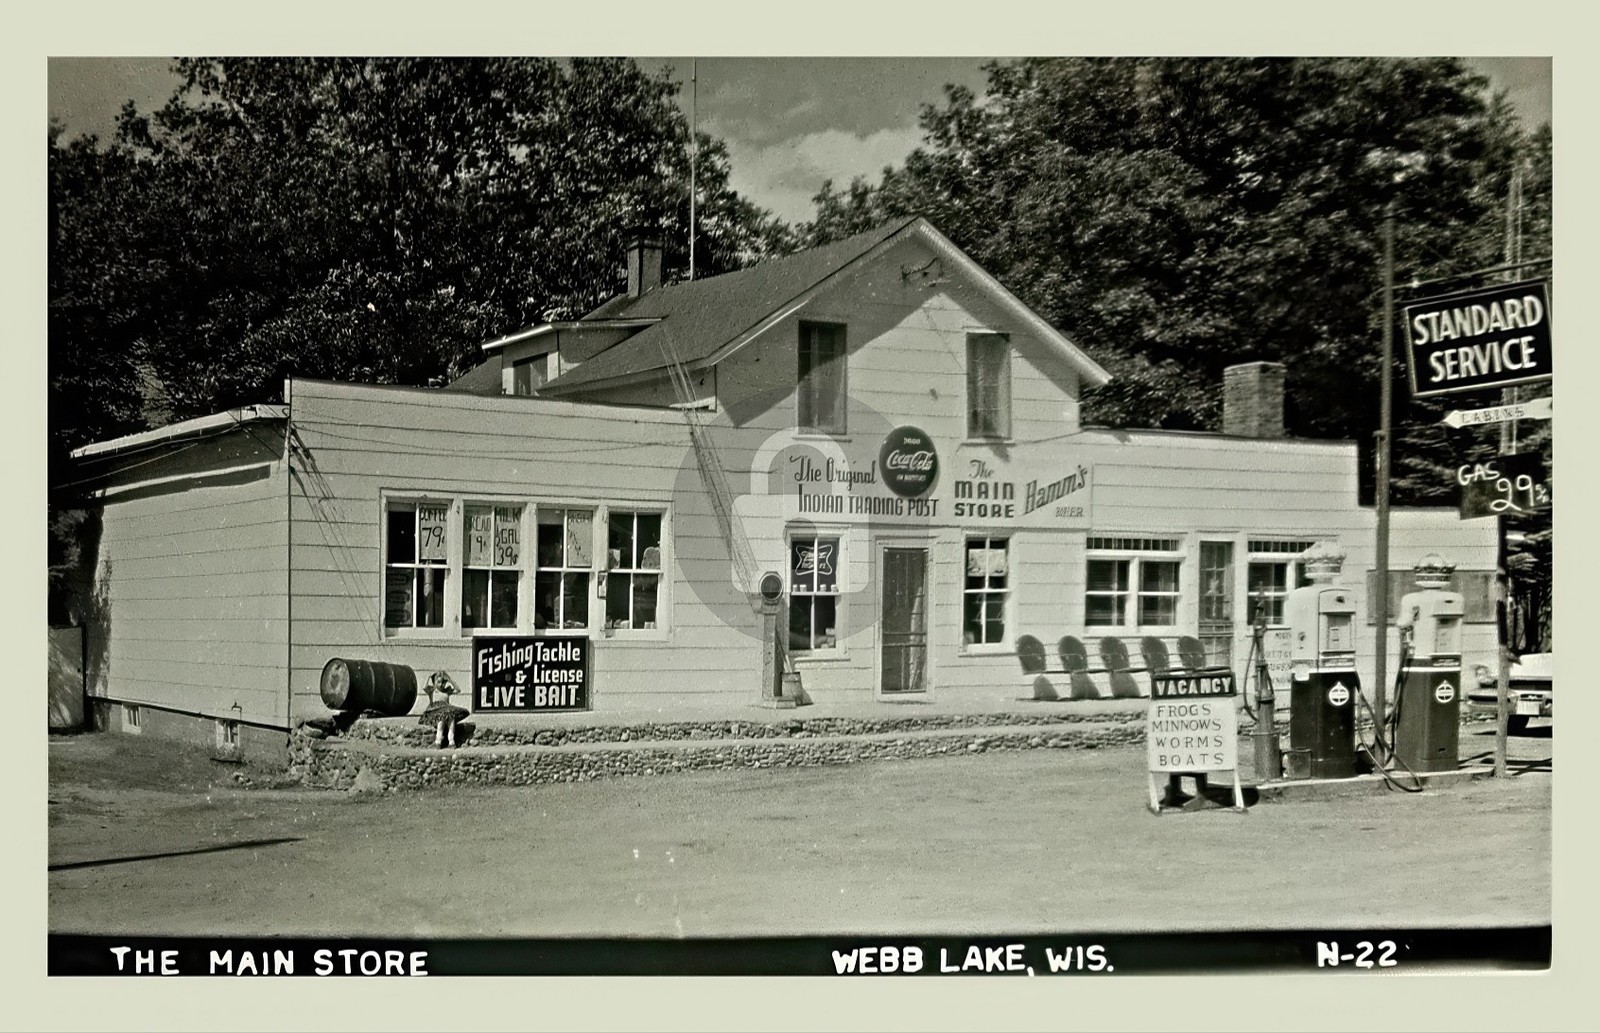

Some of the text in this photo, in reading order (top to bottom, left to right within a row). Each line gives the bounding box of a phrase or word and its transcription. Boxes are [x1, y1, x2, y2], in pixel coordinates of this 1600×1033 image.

[1413, 295, 1544, 345] STANDARD
[1429, 335, 1537, 382] SERVICE
[790, 456, 877, 491] The Original
[969, 459, 995, 478] The
[1458, 461, 1500, 486] GAS
[954, 480, 1014, 500] MAIN
[1023, 464, 1088, 515] Hamm's
[798, 484, 940, 517] INDIAN TRADING POST
[954, 502, 1014, 518] STORE
[477, 641, 581, 678] Fishing Tackle
[515, 664, 583, 683] & License
[480, 685, 579, 708] LIVE BAIT
[1155, 677, 1232, 696] VACANCY
[1157, 704, 1211, 717] FROGS
[1152, 719, 1222, 732] MINNOWS
[1156, 735, 1223, 748] WORMS
[1159, 753, 1224, 766] BOATS
